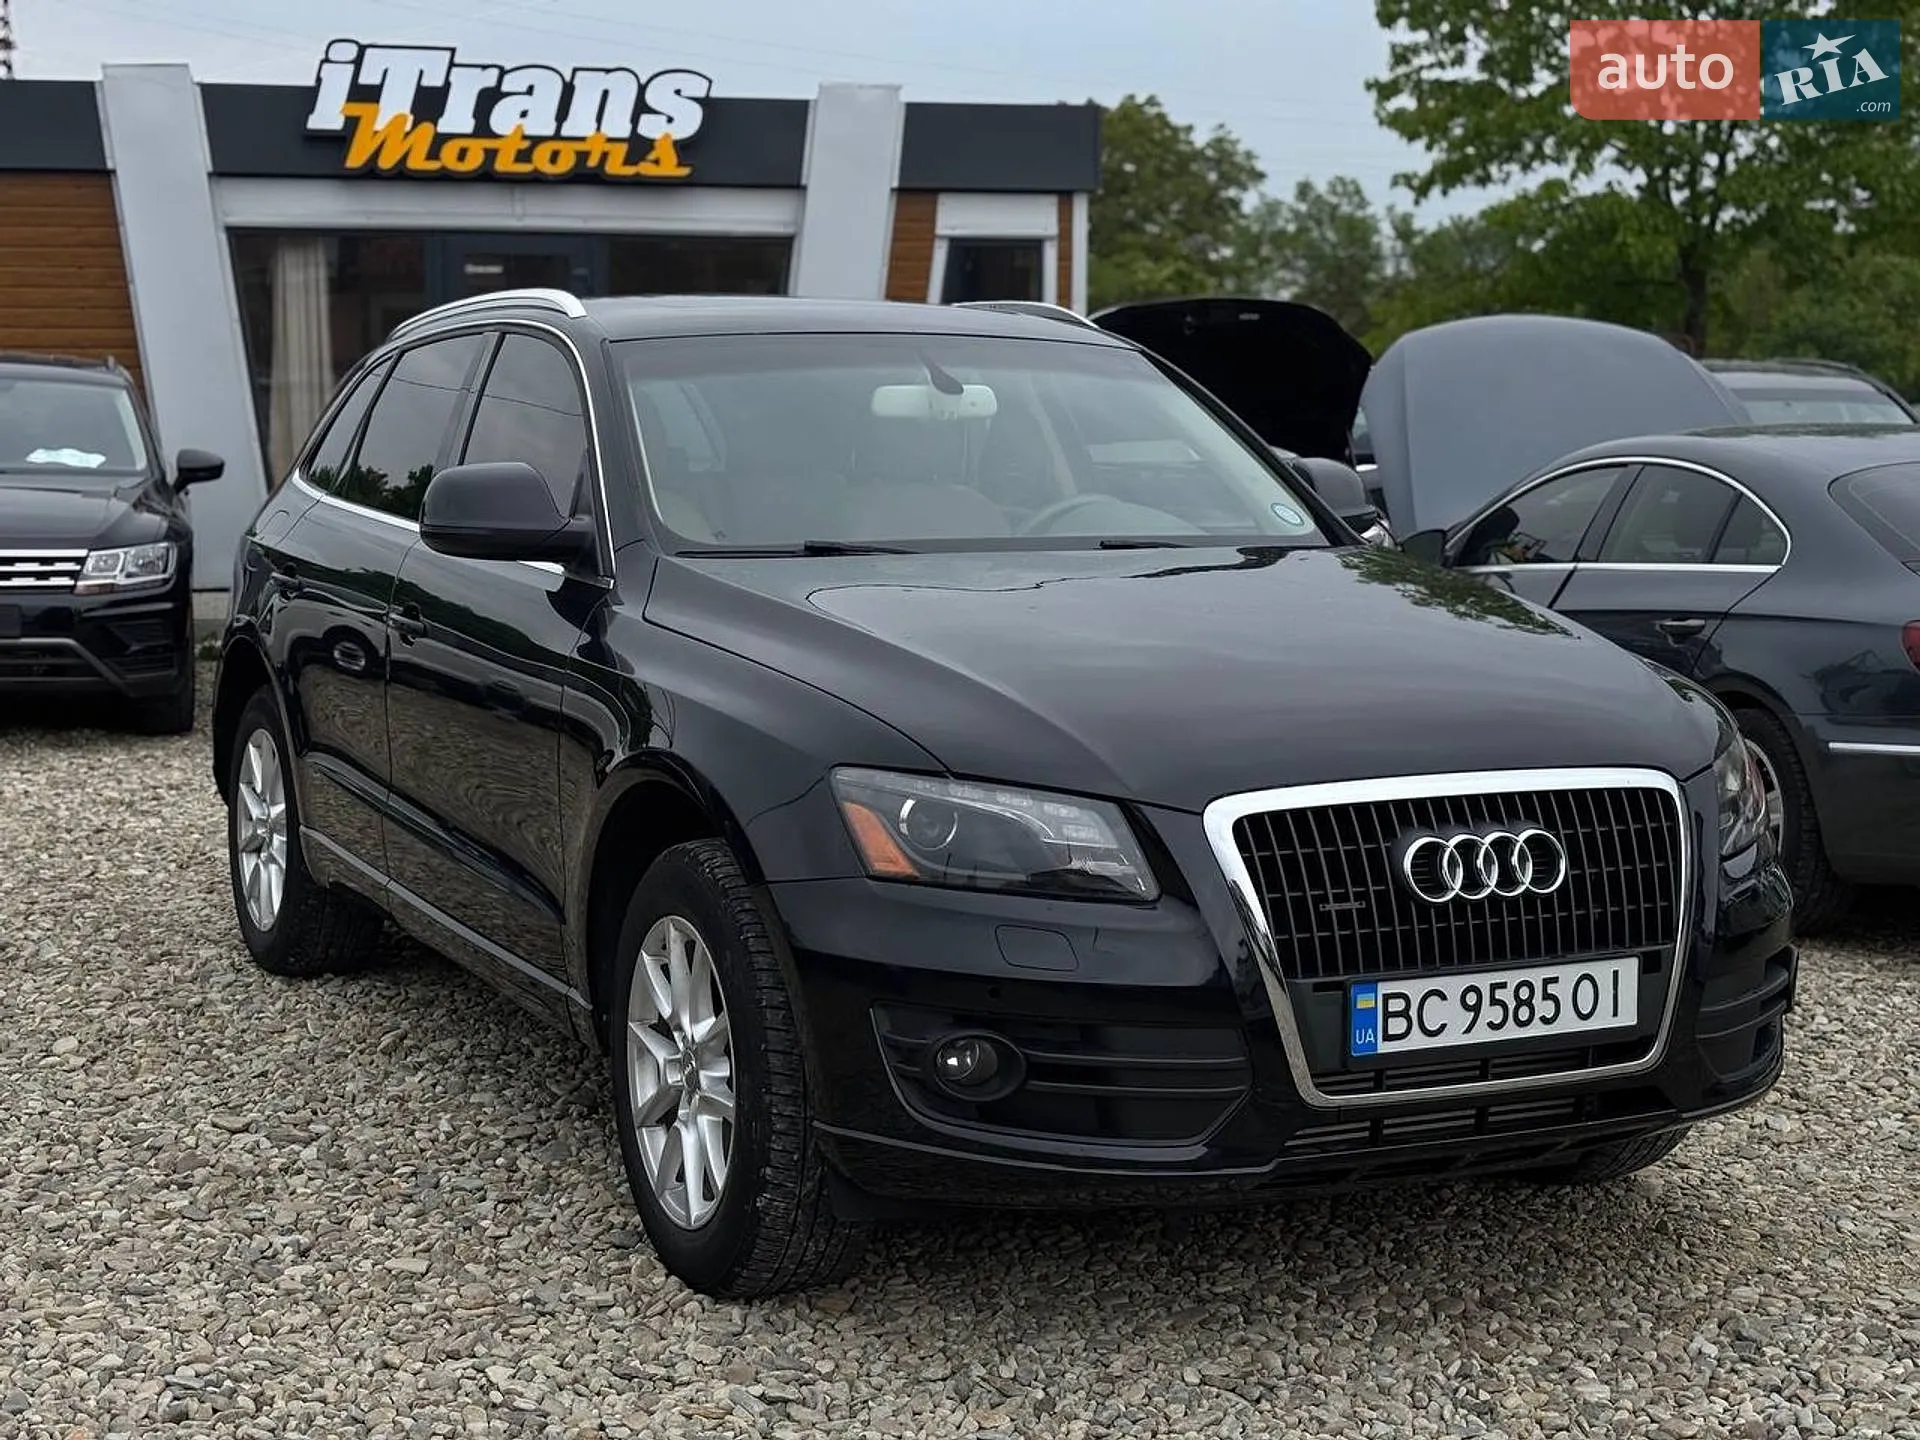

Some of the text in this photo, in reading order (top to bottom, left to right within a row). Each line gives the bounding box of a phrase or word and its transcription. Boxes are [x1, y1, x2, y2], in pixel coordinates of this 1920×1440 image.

[306, 40, 711, 141] iTrans
[341, 102, 692, 177] Motors
[1355, 1028, 1376, 1045] UA
[1381, 988, 1448, 1042] BC
[1460, 976, 1561, 1035] 9585
